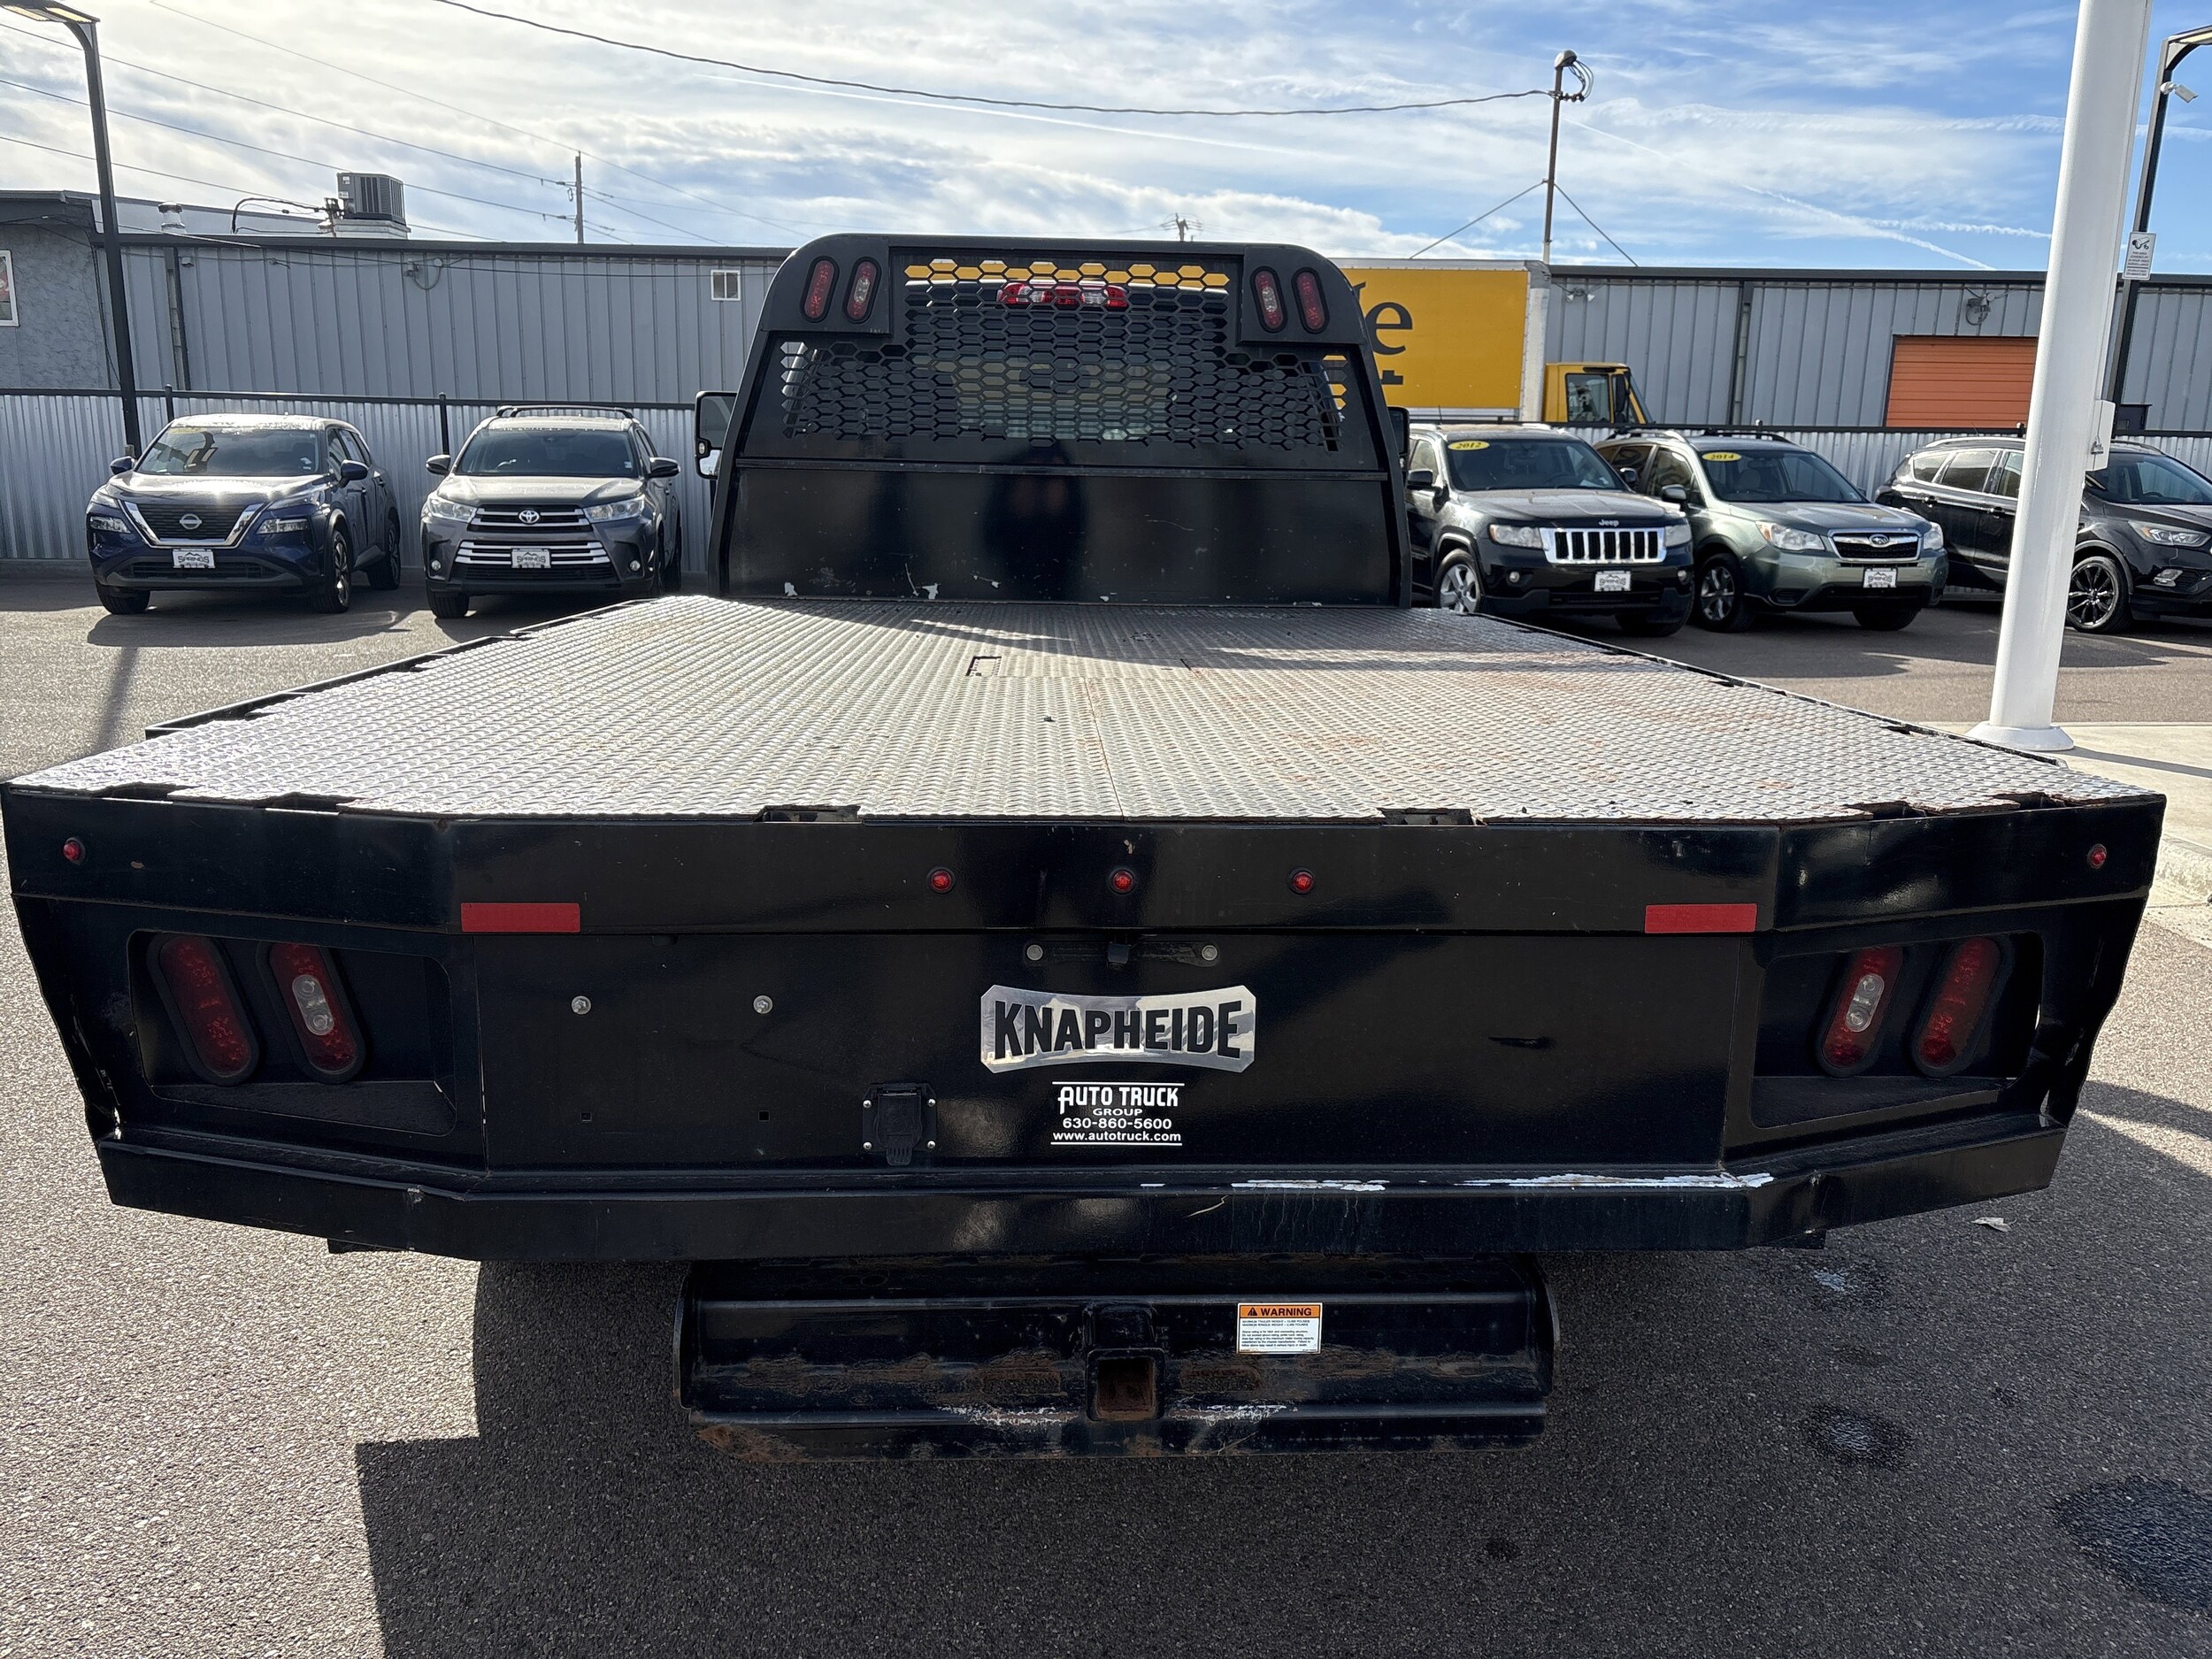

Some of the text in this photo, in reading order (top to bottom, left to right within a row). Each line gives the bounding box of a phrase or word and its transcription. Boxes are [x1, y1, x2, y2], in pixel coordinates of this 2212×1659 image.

[1598, 518, 1619, 527] Jeep
[994, 1000, 1242, 1060] KNAPHEIDE
[1057, 1086, 1179, 1115] AUTO TRUCK
[1092, 1107, 1143, 1117] GROUP
[1062, 1118, 1172, 1130] 630-860-5600
[1052, 1130, 1182, 1142] www.autotruck.com
[1260, 1307, 1312, 1317] WARNING
